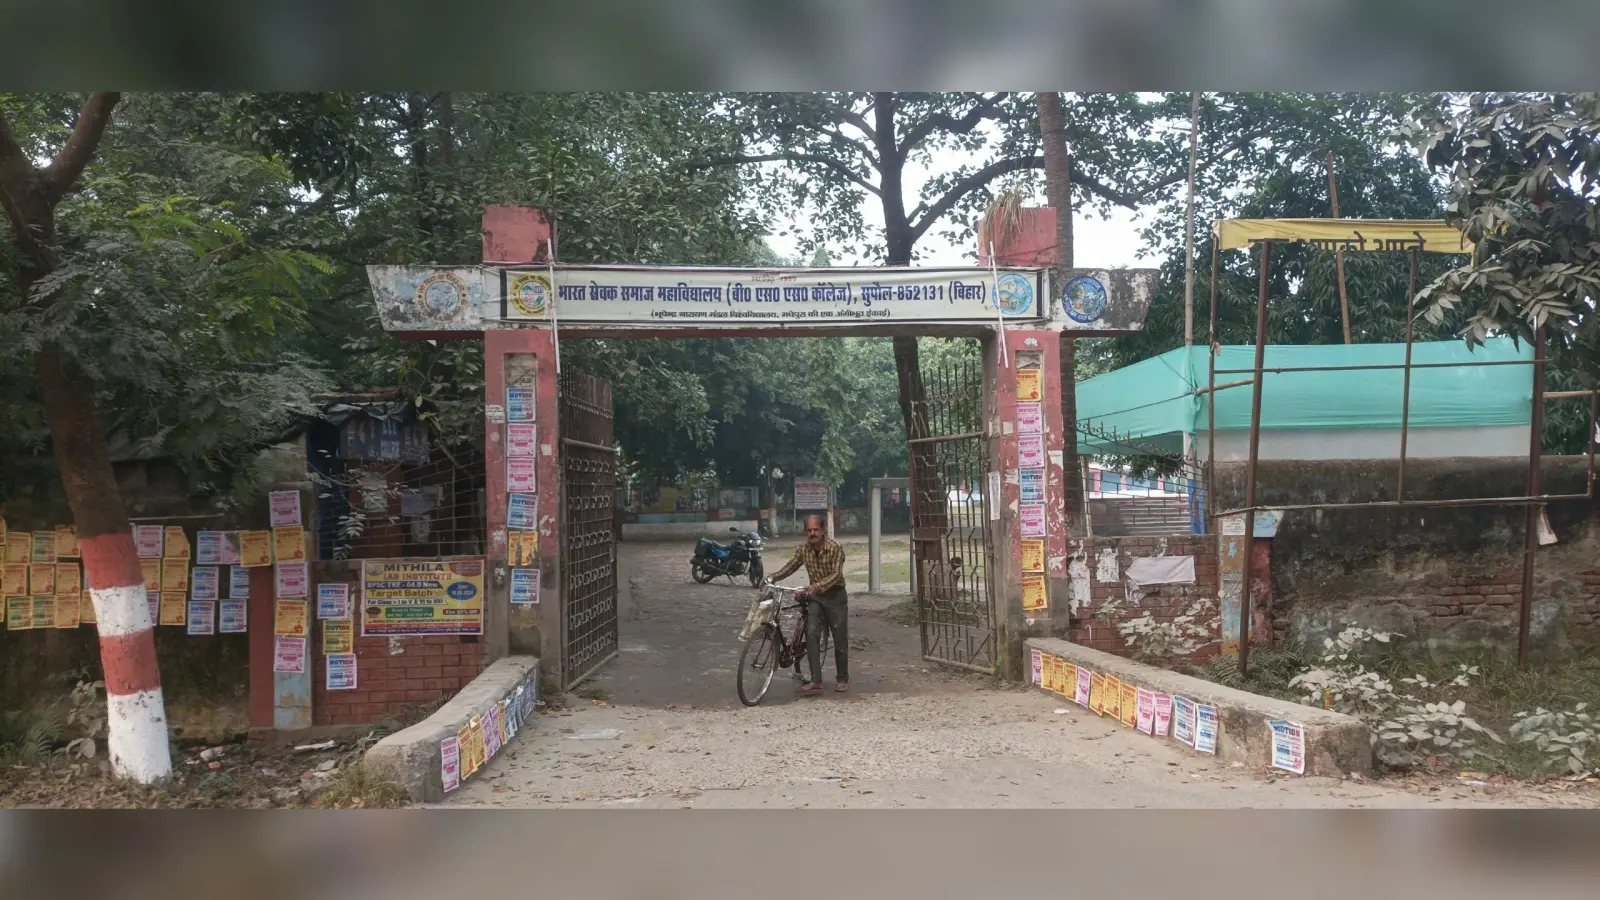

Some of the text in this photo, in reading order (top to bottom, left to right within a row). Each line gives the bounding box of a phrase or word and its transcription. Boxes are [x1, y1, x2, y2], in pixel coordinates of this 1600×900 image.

[559, 285, 586, 301] भारत
[589, 281, 618, 301] सेवक
[621, 285, 654, 301] समाज
[657, 282, 722, 302] महाविद्यालय
[861, 281, 944, 306] सुपौल-852131
[949, 281, 986, 304] (बिहार)
[782, 310, 806, 319] मधेपुरा
[384, 564, 444, 572] MITHILA
[402, 572, 452, 580] INSTITUTE
[367, 581, 387, 589] BPSC
[370, 589, 433, 598] Target Batch
[1273, 725, 1301, 738] MOTION
